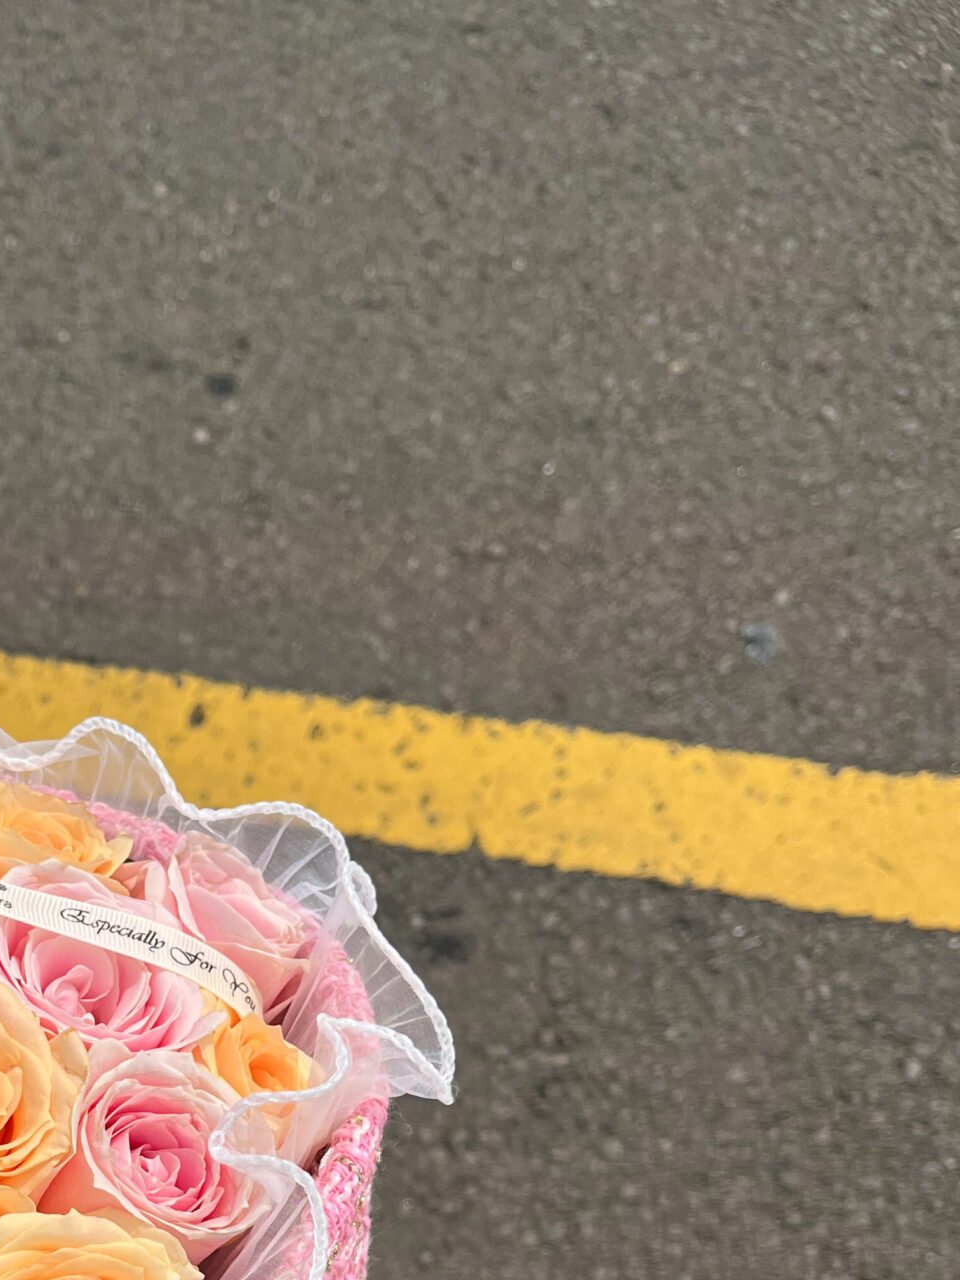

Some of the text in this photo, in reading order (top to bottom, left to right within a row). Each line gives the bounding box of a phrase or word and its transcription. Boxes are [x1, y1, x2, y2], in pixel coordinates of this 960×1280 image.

[60, 907, 256, 1011] Especially For You
